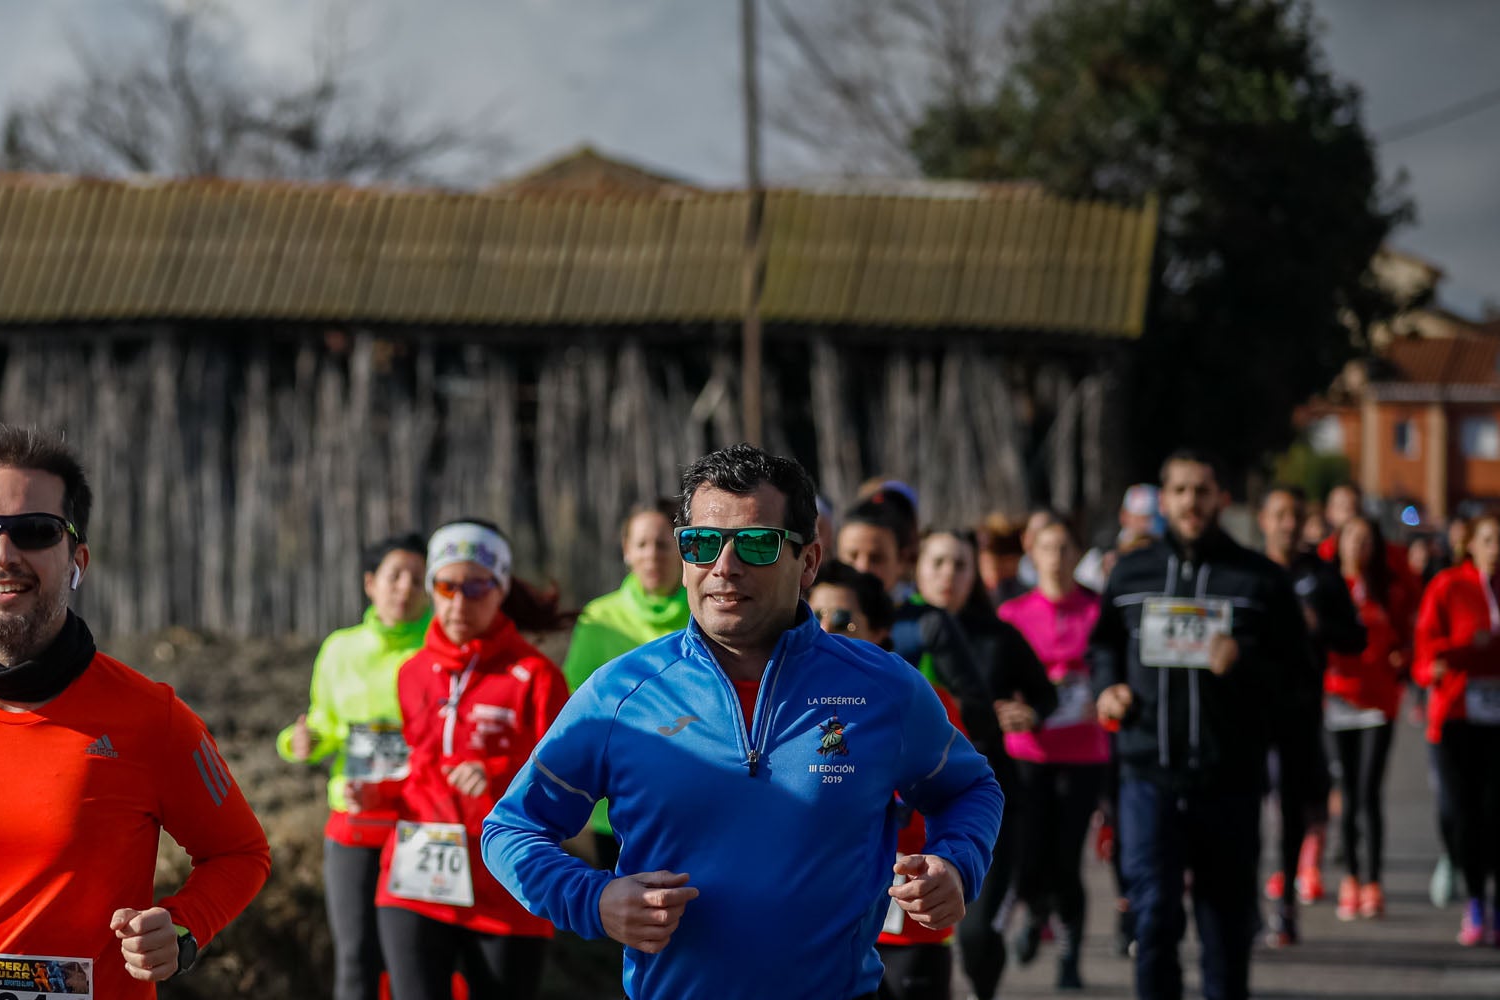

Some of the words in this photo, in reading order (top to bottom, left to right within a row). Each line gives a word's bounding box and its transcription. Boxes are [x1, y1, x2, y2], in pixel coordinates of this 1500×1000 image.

[820, 696, 867, 705] DESÉRTICA
[808, 764, 817, 772] III
[819, 764, 855, 773] EDICIÓN
[822, 775, 843, 783] 2019
[416, 847, 462, 874] 210
